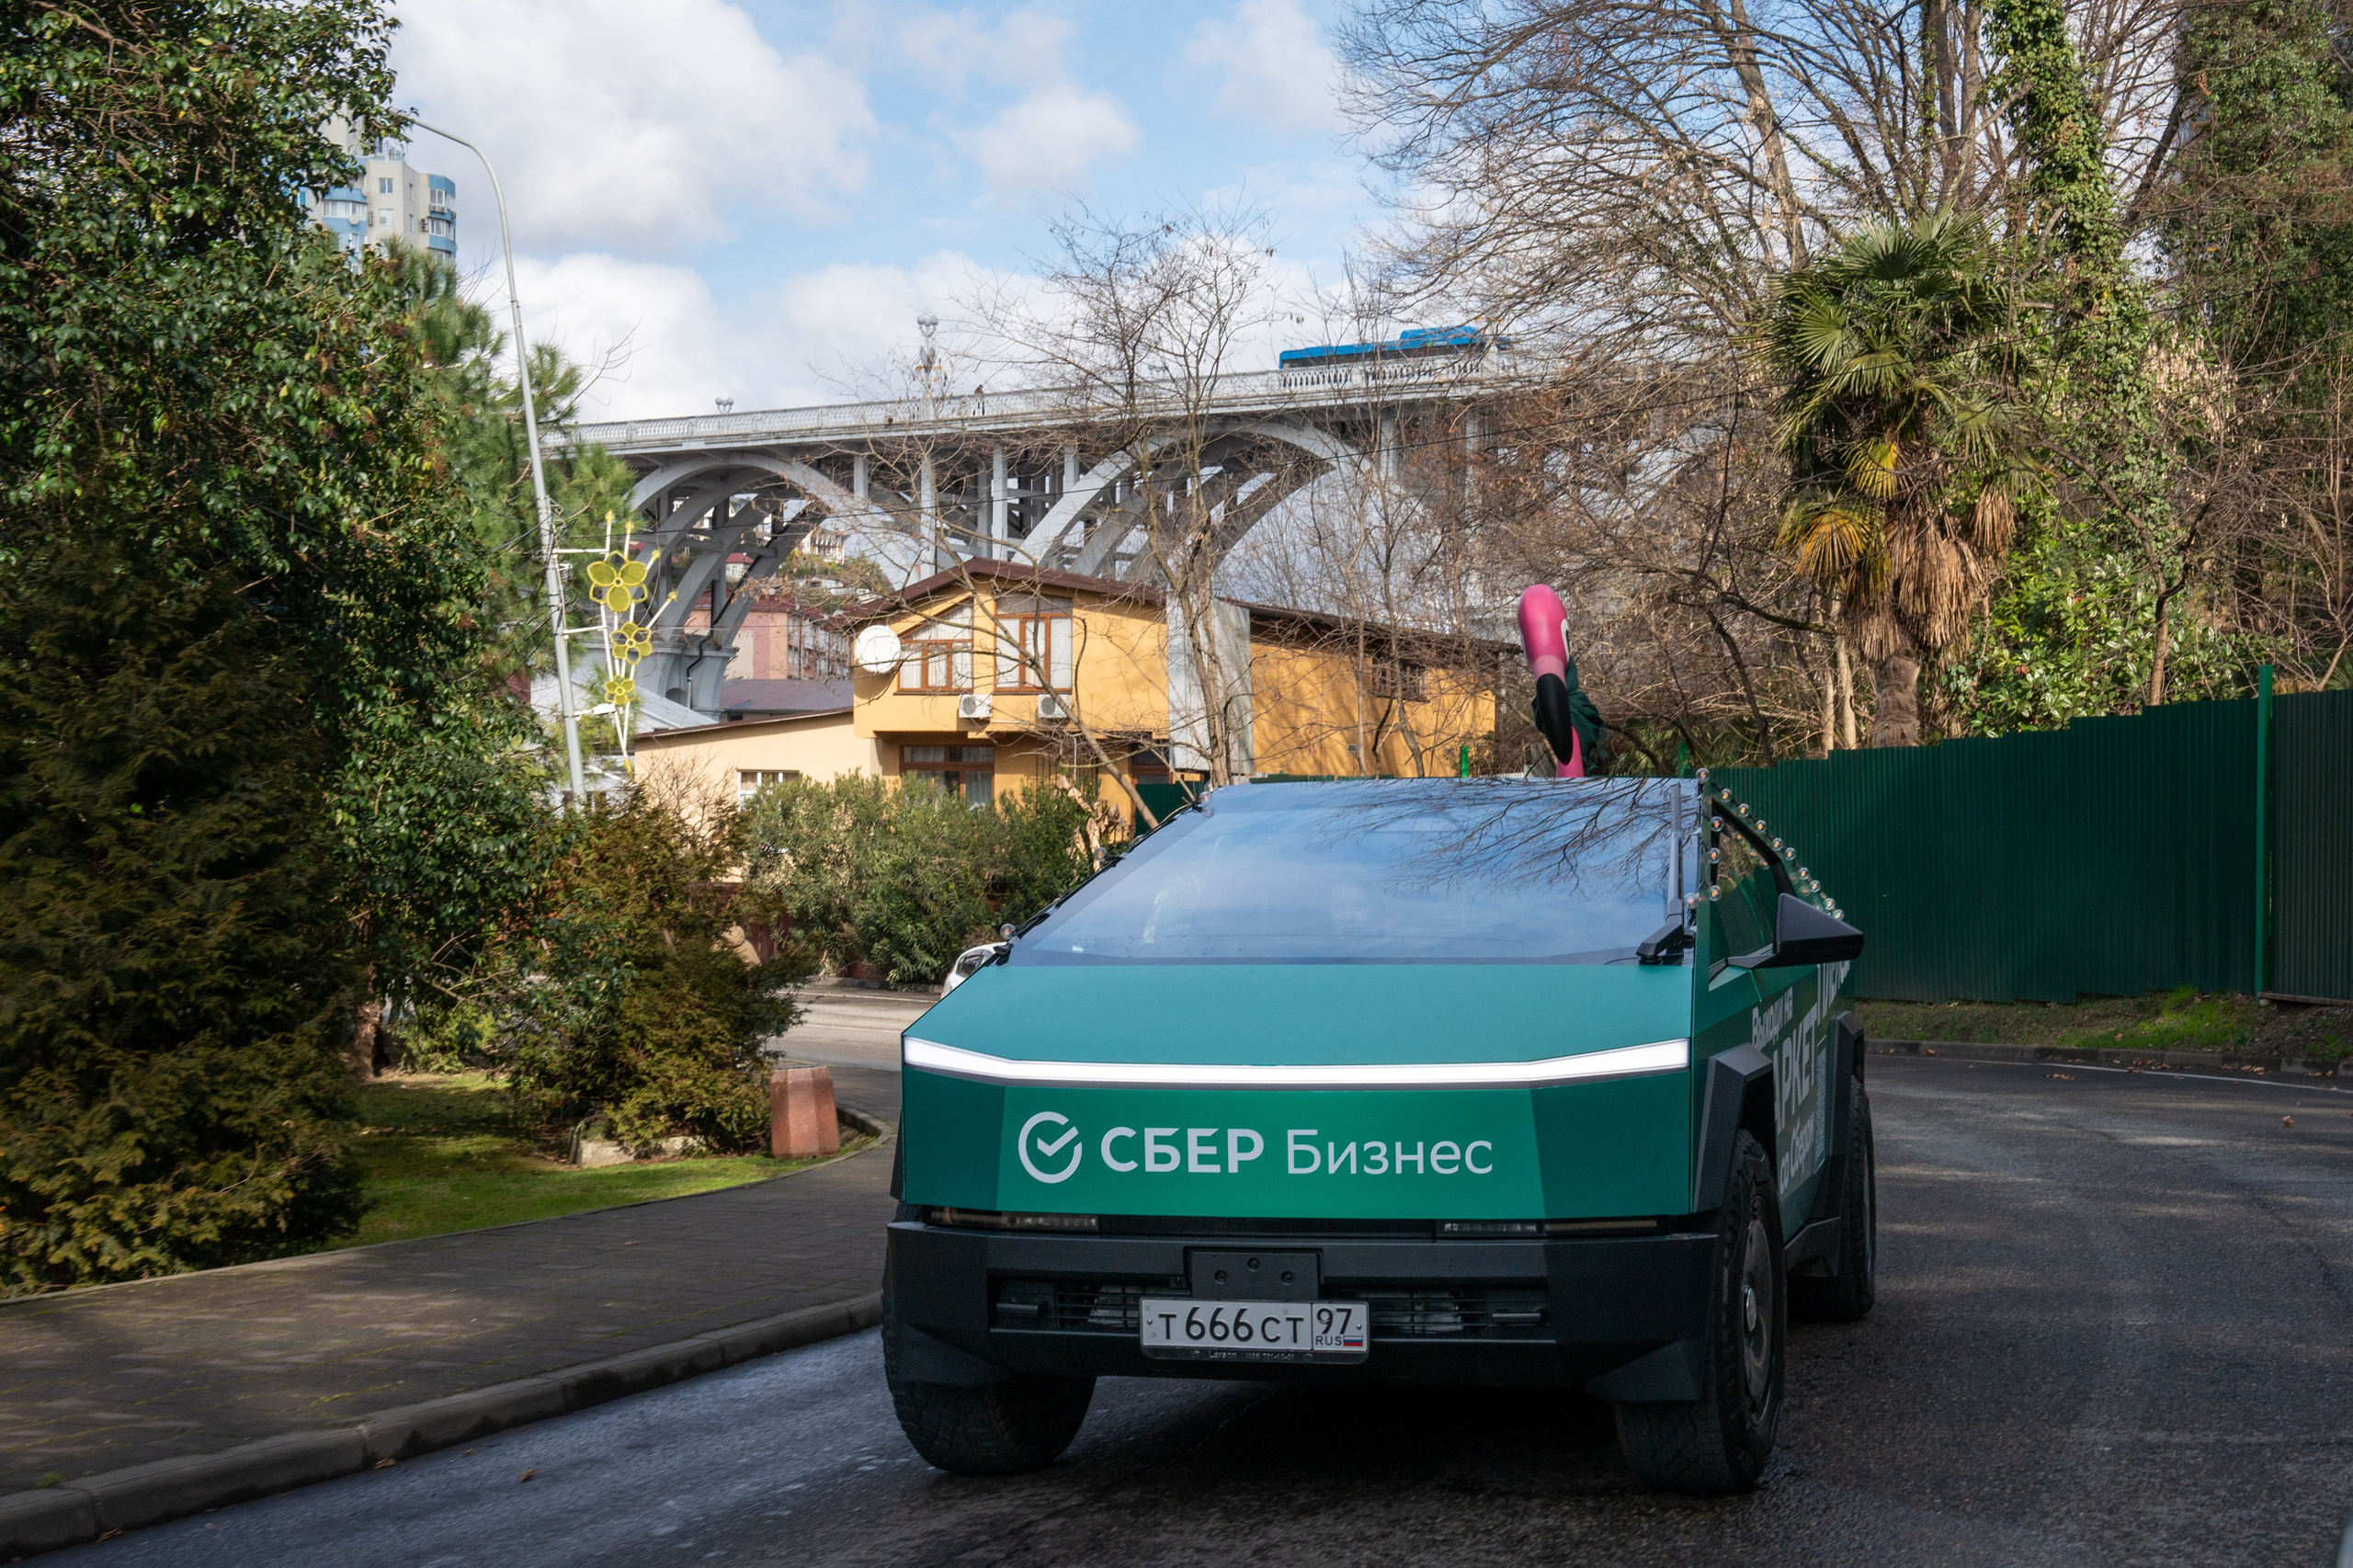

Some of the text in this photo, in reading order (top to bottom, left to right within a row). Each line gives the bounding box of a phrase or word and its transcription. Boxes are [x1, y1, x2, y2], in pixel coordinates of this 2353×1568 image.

[1752, 986, 1793, 1051] Выходи на
[1100, 1126, 1494, 1176] СБЕР Бизнес
[1316, 1307, 1353, 1335] 97
[1209, 1350, 1237, 1359] Larson
[1315, 1335, 1343, 1346] RUS
